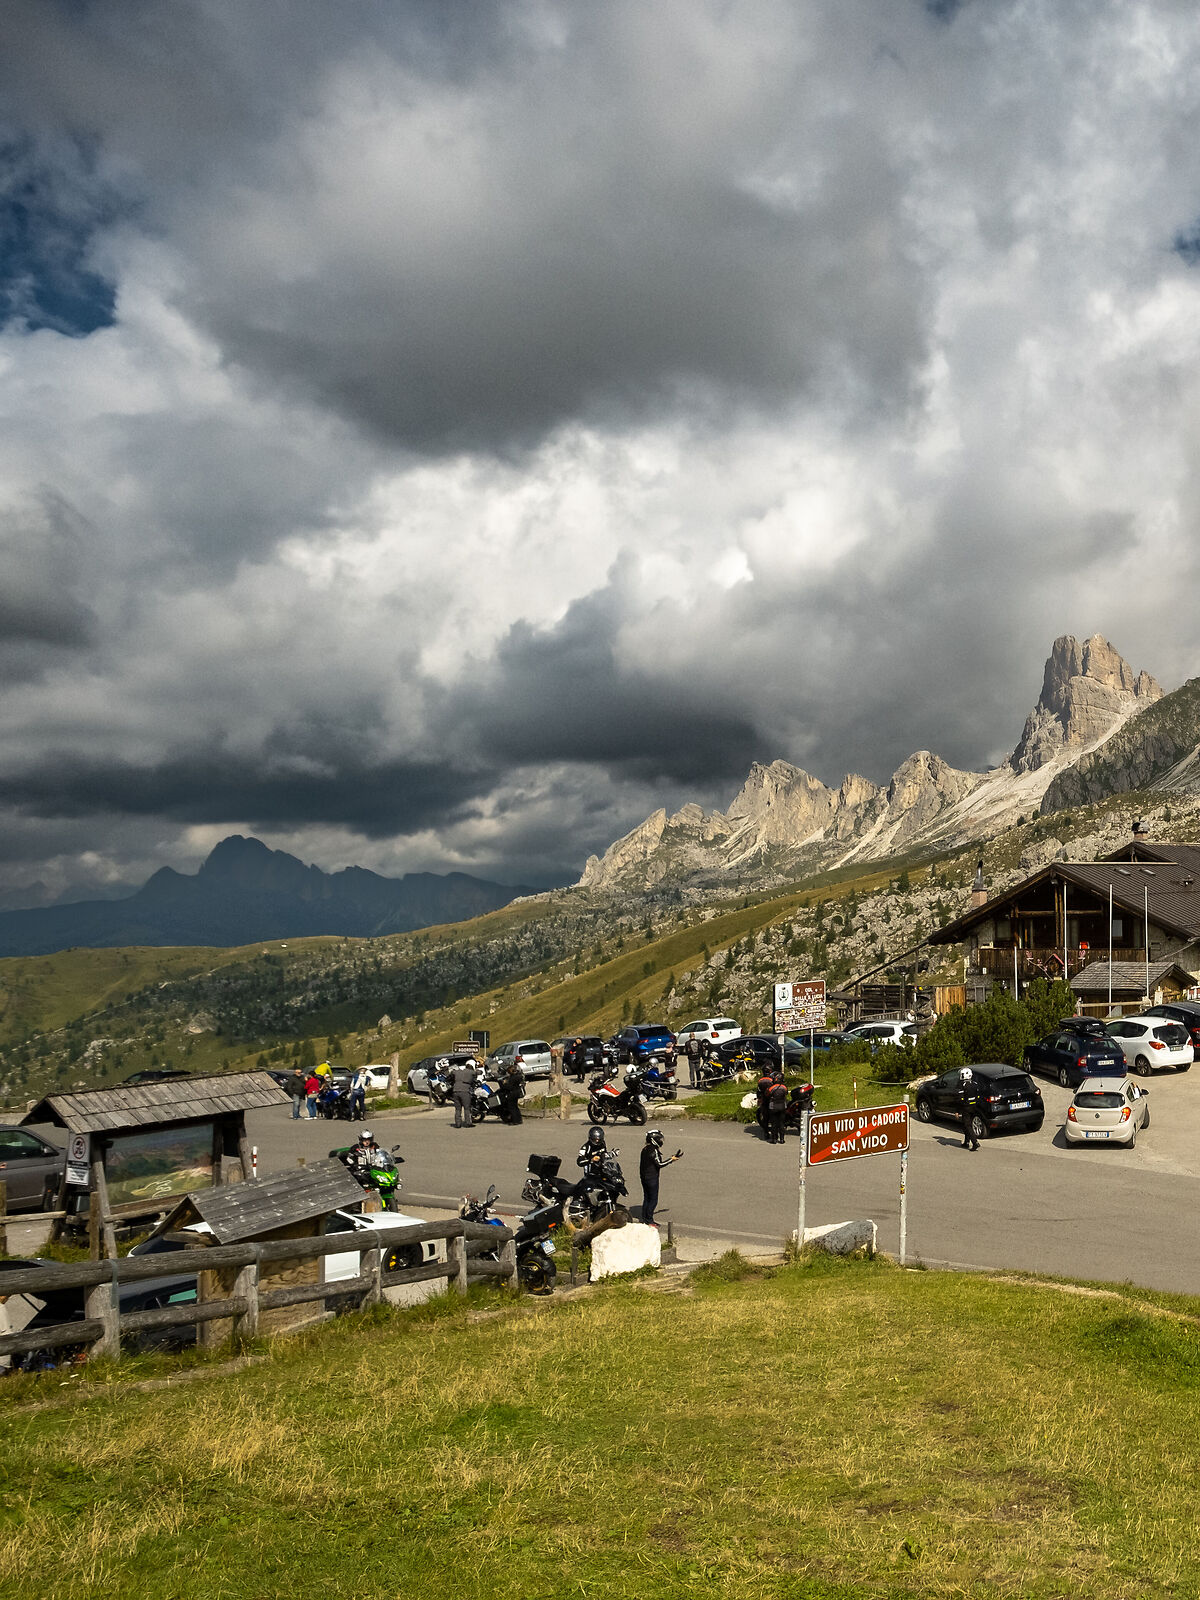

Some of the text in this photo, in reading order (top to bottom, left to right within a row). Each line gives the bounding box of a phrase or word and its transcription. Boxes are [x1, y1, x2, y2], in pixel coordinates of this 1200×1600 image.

[812, 1111, 906, 1136] SAN VITO DI CADORE
[831, 1133, 888, 1154] SAN VIDO
